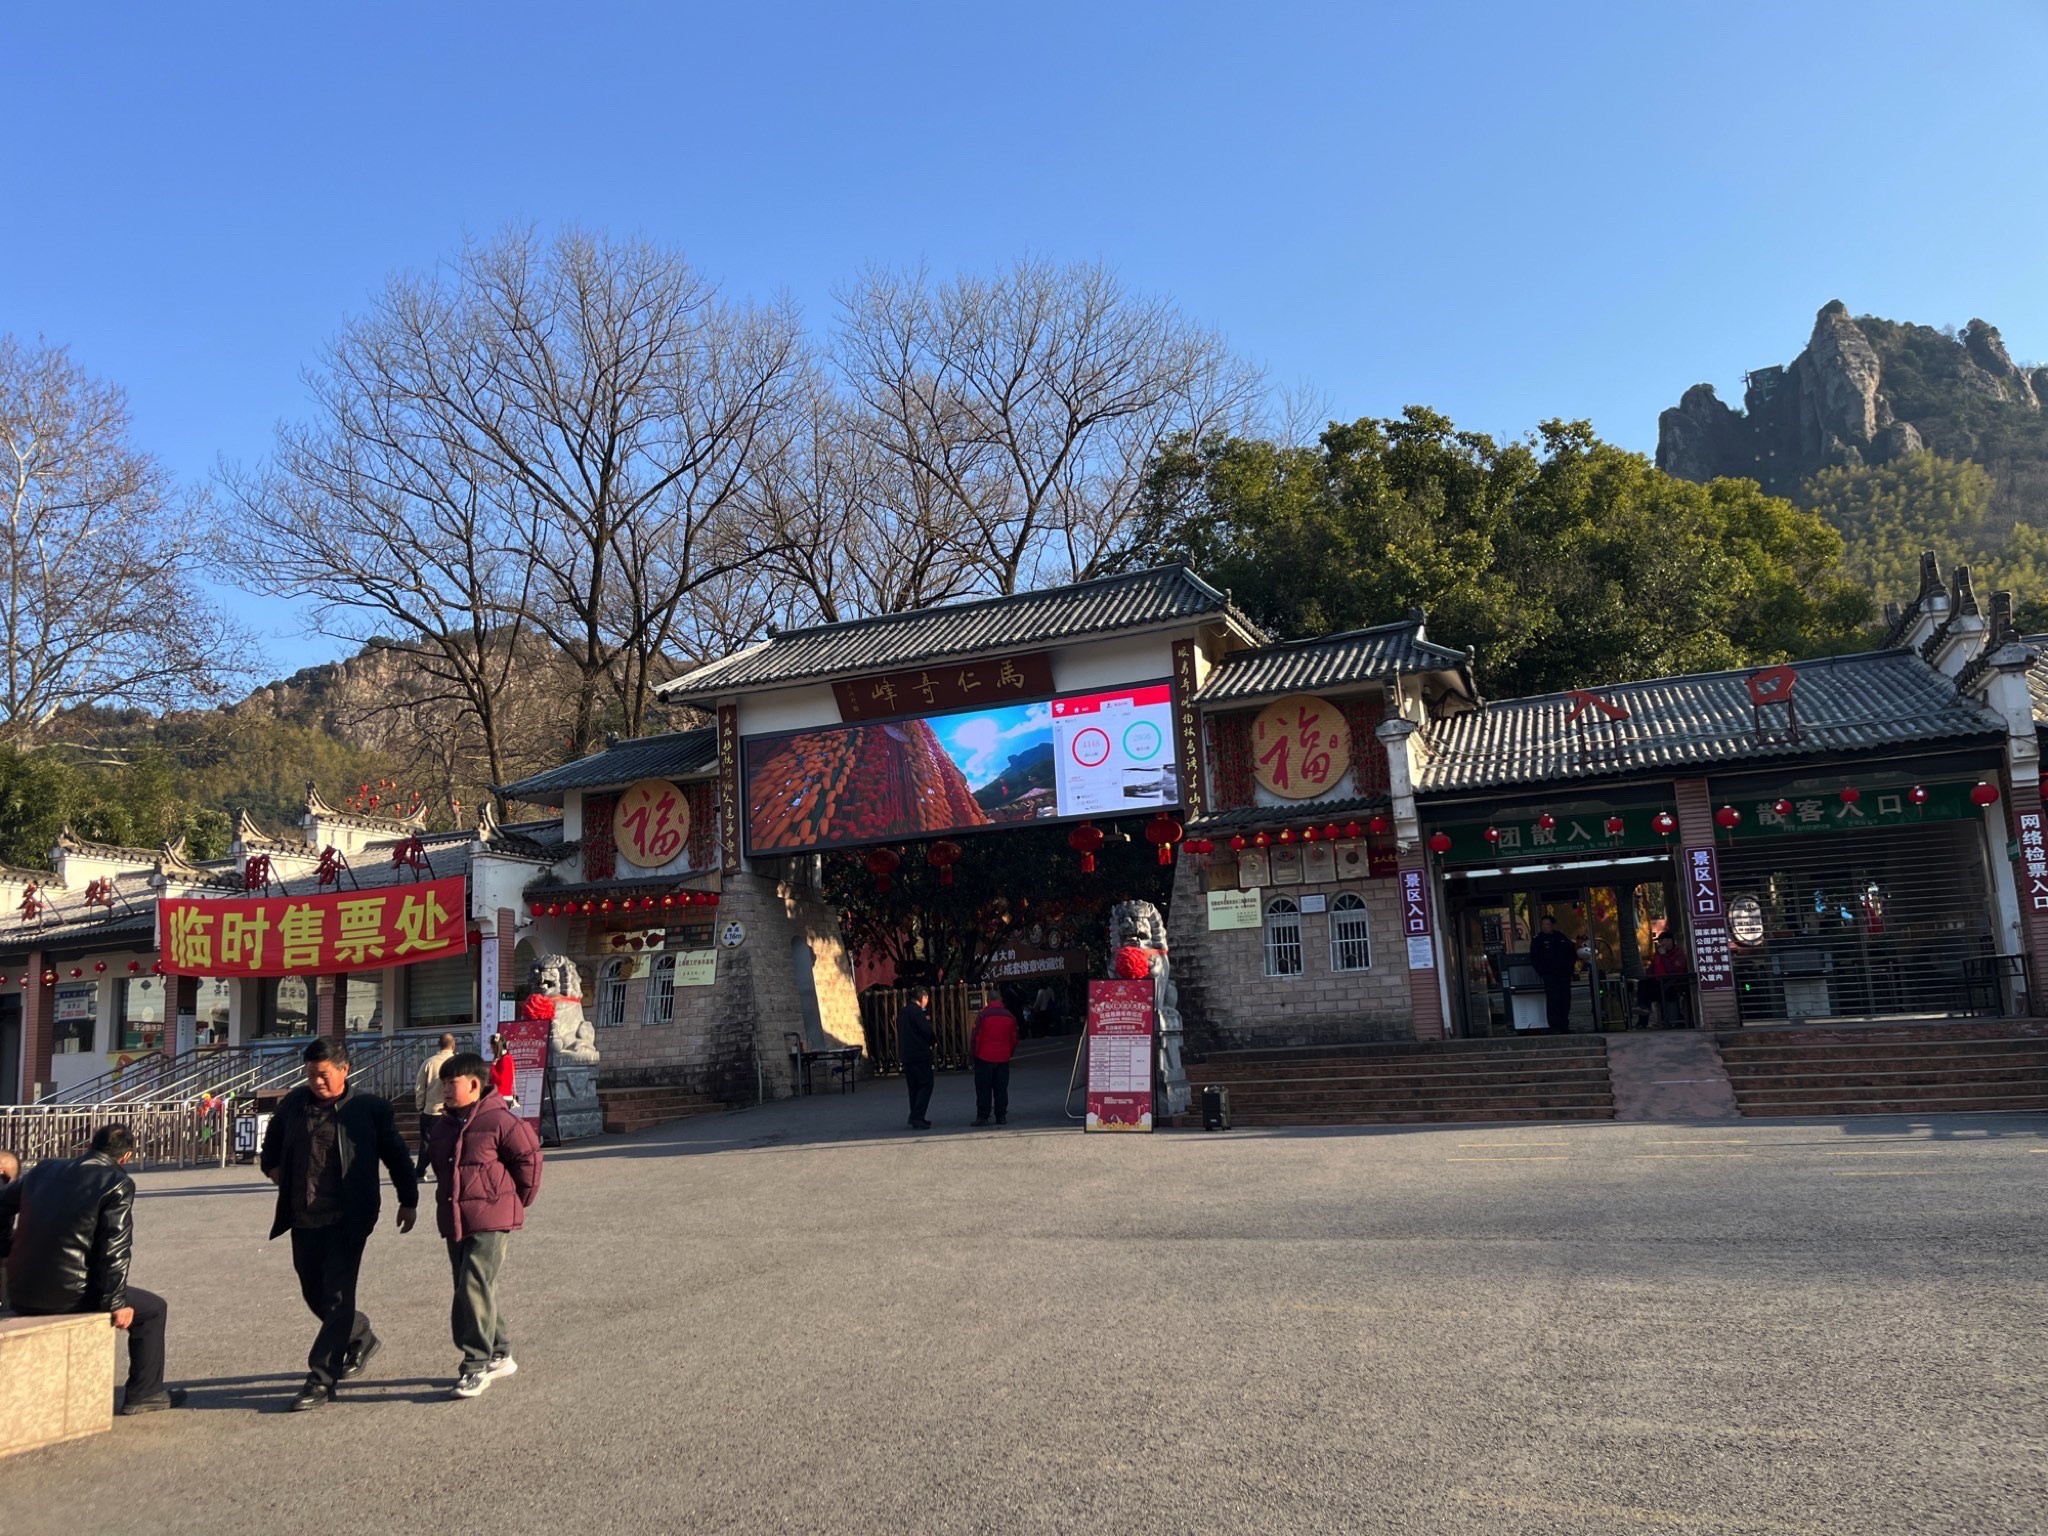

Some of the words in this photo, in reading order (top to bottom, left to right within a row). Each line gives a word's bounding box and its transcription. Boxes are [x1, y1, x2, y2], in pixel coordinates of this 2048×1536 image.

[872, 659, 1025, 711] 馬仁奇峰
[1564, 665, 1796, 724] 入口
[1259, 706, 1331, 790] 福
[622, 790, 681, 858] 福
[1756, 795, 1903, 826] 散客入口
[1797, 822, 1831, 831] entrance
[244, 834, 430, 890] 服务处
[1691, 851, 1714, 912] 景区入口
[2021, 814, 2048, 909] 网络检票入口
[170, 890, 450, 970] 临时售票处
[1404, 873, 1424, 931] 景区入口
[723, 932, 742, 941] 4.16m
[1695, 928, 1725, 936] 国家森林
[1696, 937, 1726, 945] 公园严禁
[1697, 946, 1728, 954] 携带火种
